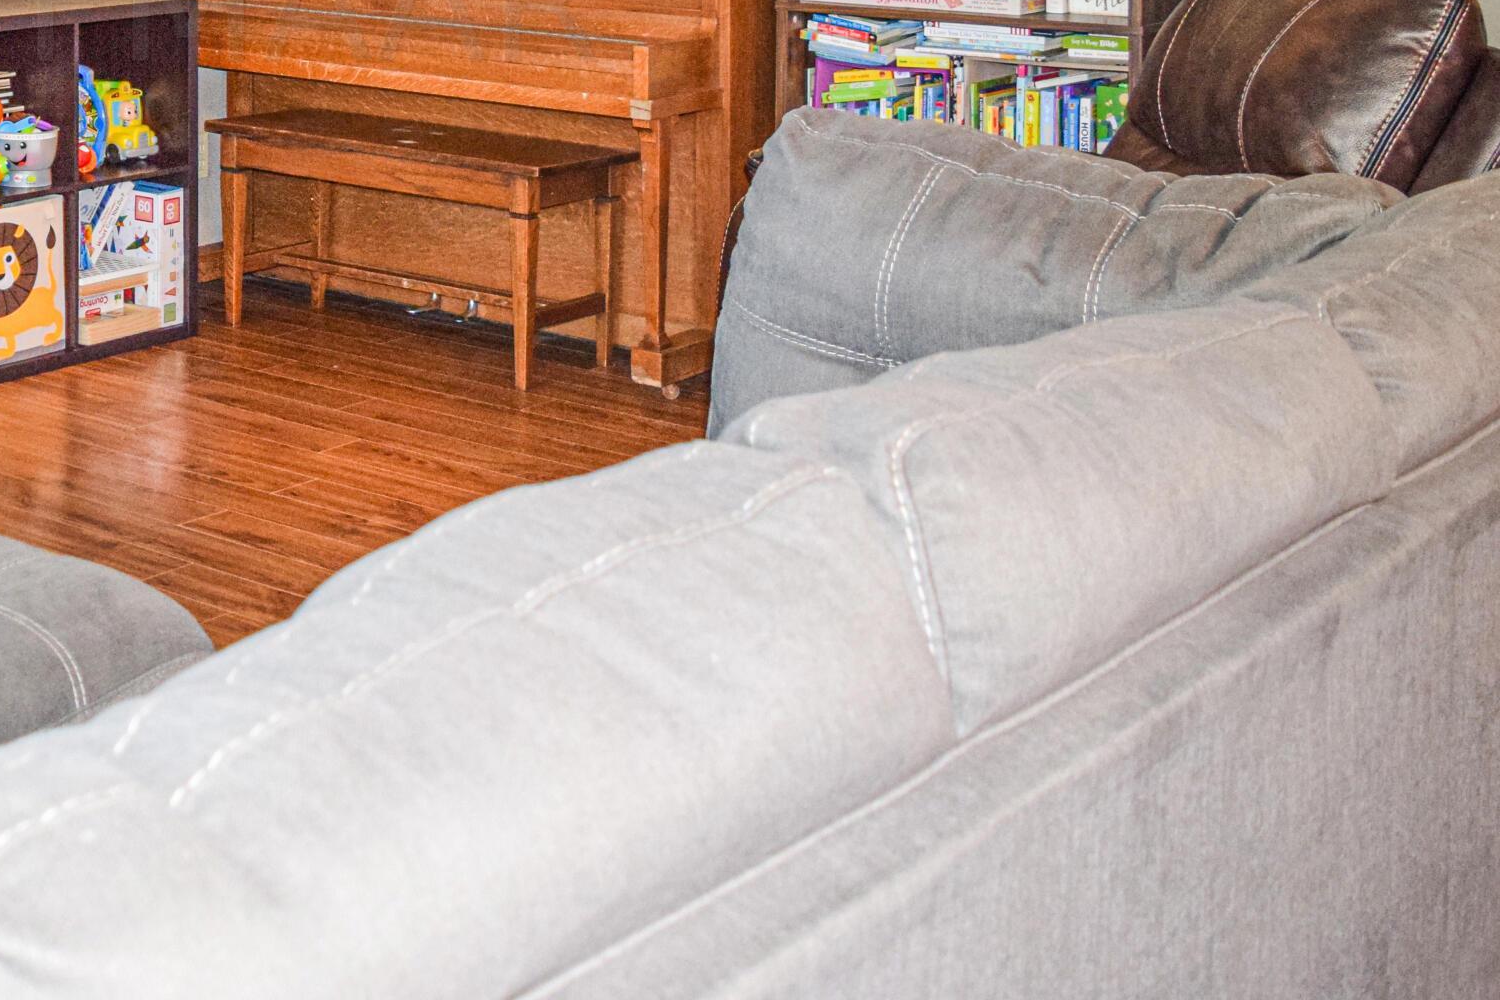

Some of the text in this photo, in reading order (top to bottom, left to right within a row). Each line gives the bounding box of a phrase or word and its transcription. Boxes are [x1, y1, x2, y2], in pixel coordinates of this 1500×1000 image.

[1099, 39, 1119, 47] Bible
[1081, 122, 1089, 152] HOUSE
[138, 201, 150, 213] 60
